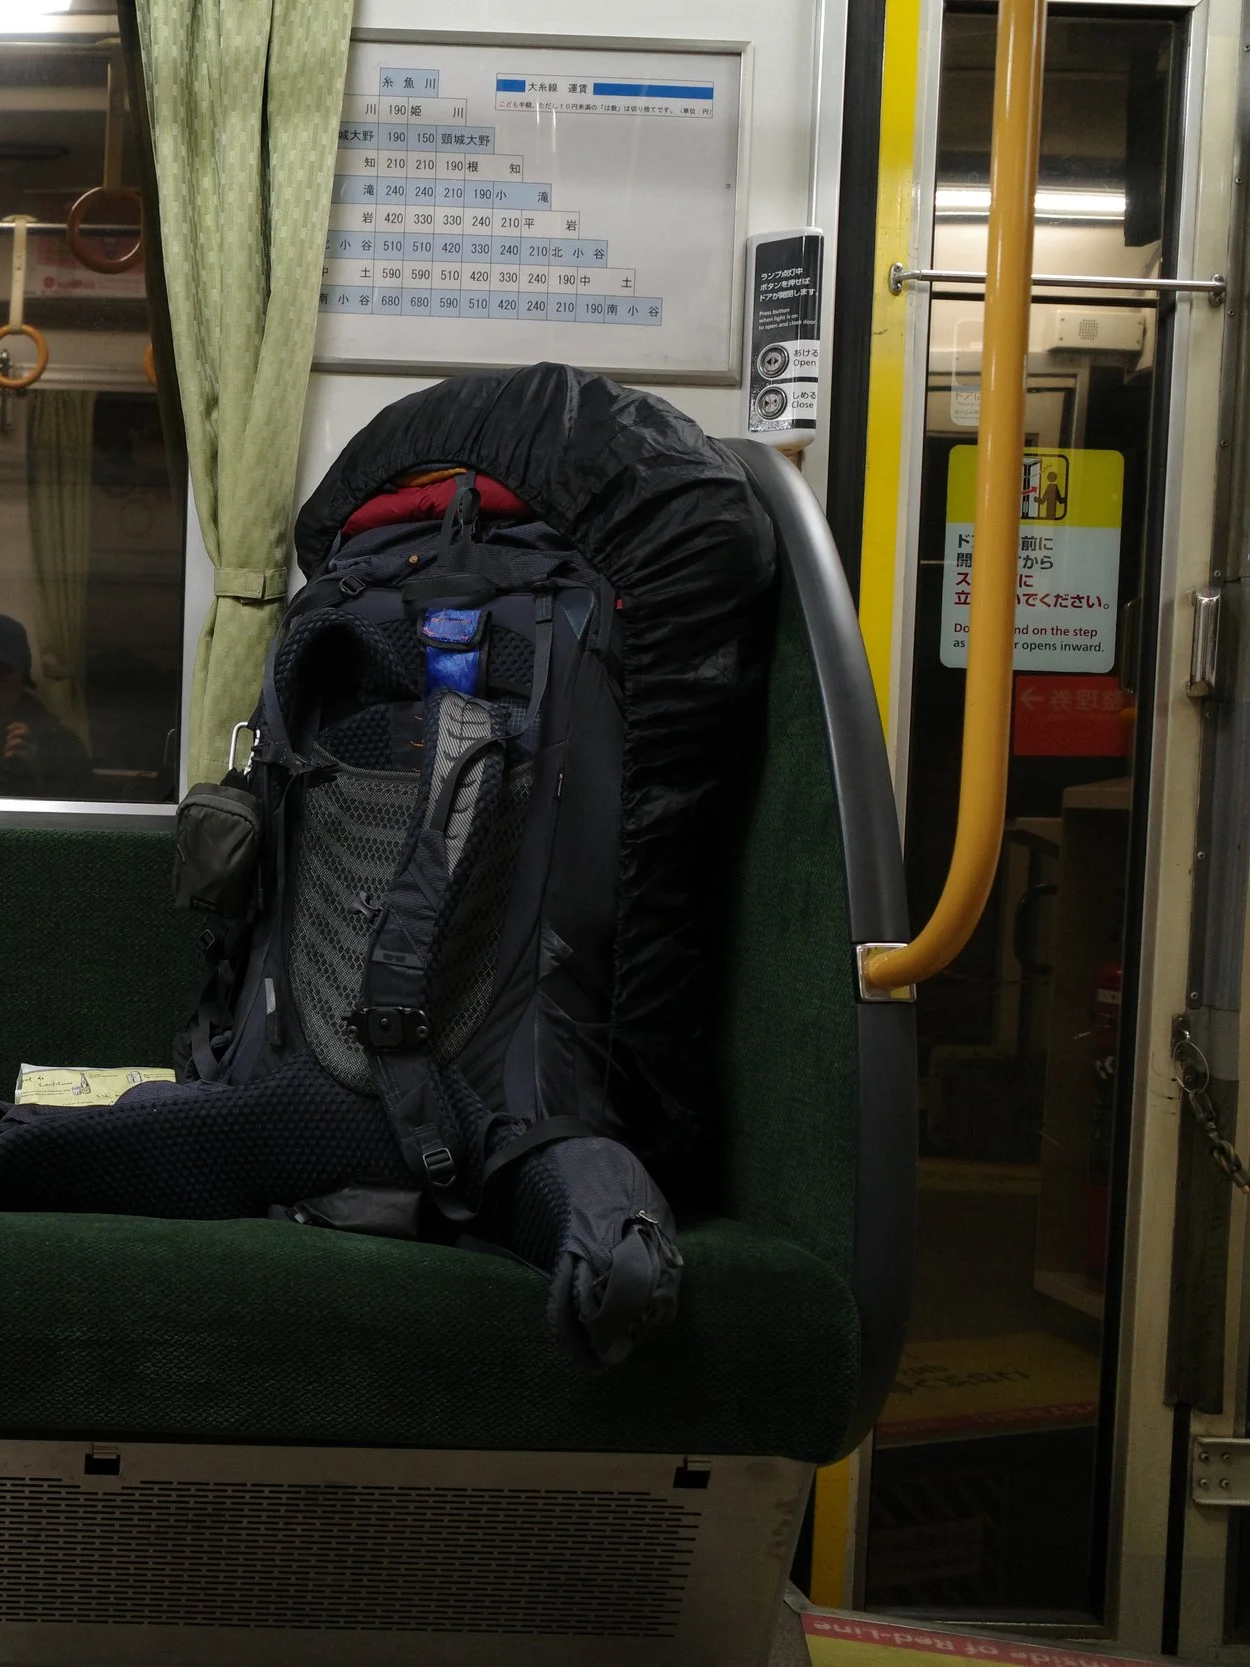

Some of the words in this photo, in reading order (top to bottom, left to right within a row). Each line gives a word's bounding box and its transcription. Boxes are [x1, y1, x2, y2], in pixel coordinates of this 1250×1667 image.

[382, 76, 436, 90] 糸魚川
[527, 82, 558, 93] 大糸線
[568, 83, 588, 94] 運賃
[388, 104, 407, 116] 190
[410, 105, 464, 118] 姫川
[387, 132, 406, 143] 190
[416, 133, 435, 144] 150
[386, 158, 406, 169] 210
[415, 159, 435, 170] 210
[445, 161, 464, 172] 190
[467, 161, 521, 175] 根知
[385, 185, 405, 196] 240
[415, 186, 434, 197] 240
[444, 187, 463, 198] 210
[473, 189, 492, 200] 190
[495, 190, 549, 203] 小滝
[384, 212, 404, 224] 420
[413, 214, 433, 225] 330
[443, 215, 462, 226] 330
[472, 216, 491, 227] 240
[501, 217, 520, 228] 210
[524, 217, 578, 232] 平岩
[383, 241, 402, 252] 510
[412, 242, 432, 253] 510
[441, 243, 461, 254] 420
[470, 244, 490, 255] 330
[500, 245, 519, 256] 240
[529, 246, 548, 257] 210
[551, 246, 605, 260] 北小谷
[382, 267, 401, 279] 590
[411, 269, 431, 280] 590
[440, 270, 460, 281] 510
[469, 271, 489, 282] 420
[499, 272, 518, 283] 330
[528, 273, 547, 284] 240
[557, 274, 576, 285] 190
[579, 275, 633, 288] 中土
[760, 277, 810, 292] ボタンを押せば
[381, 295, 400, 307] 680
[410, 297, 429, 308] 680
[439, 298, 459, 309] 590
[468, 299, 488, 310] 510
[497, 300, 517, 311] 420
[526, 300, 546, 312] 240
[555, 302, 575, 313] 210
[585, 303, 603, 314] 190
[606, 304, 660, 318] 南小谷
[774, 315, 786, 323] light
[765, 323, 778, 331] open
[793, 349, 819, 358] あける
[793, 358, 817, 368] Open
[792, 391, 817, 400] しめる
[791, 401, 814, 409] Close
[1032, 628, 1048, 636] on
[1051, 626, 1070, 637] the
[1073, 627, 1098, 638] step
[953, 639, 966, 648] as
[1022, 640, 1057, 652] opens
[1060, 641, 1104, 653] inward.
[813, 1620, 956, 1652] Red-Line
